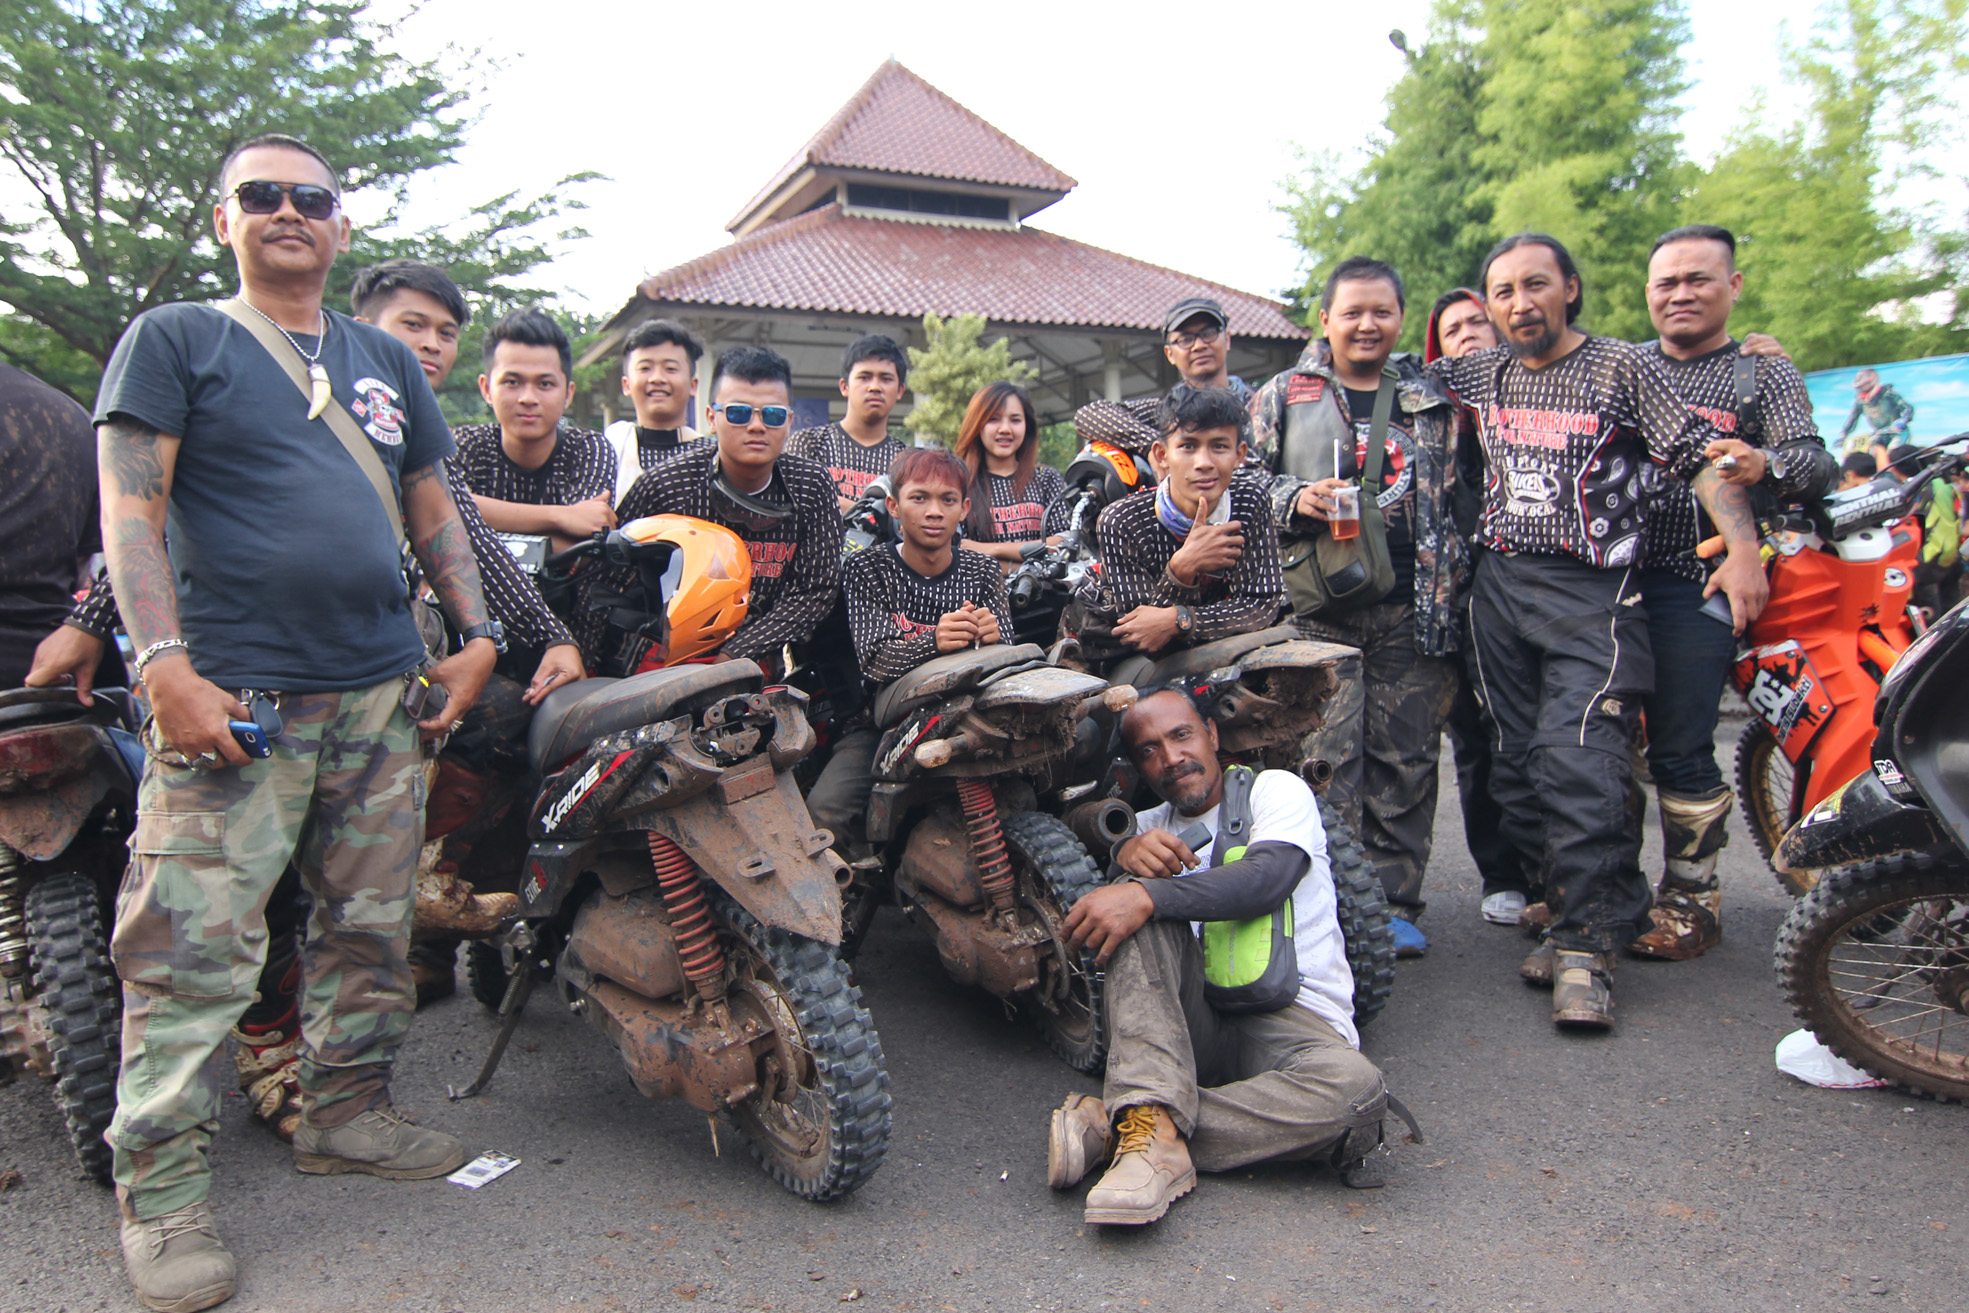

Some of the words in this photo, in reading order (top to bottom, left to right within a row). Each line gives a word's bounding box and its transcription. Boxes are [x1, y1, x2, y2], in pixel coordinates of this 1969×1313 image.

[1829, 487, 1902, 520] RENTHAL
[1833, 496, 1904, 529] RENTHAL
[1748, 669, 1796, 727] DC
